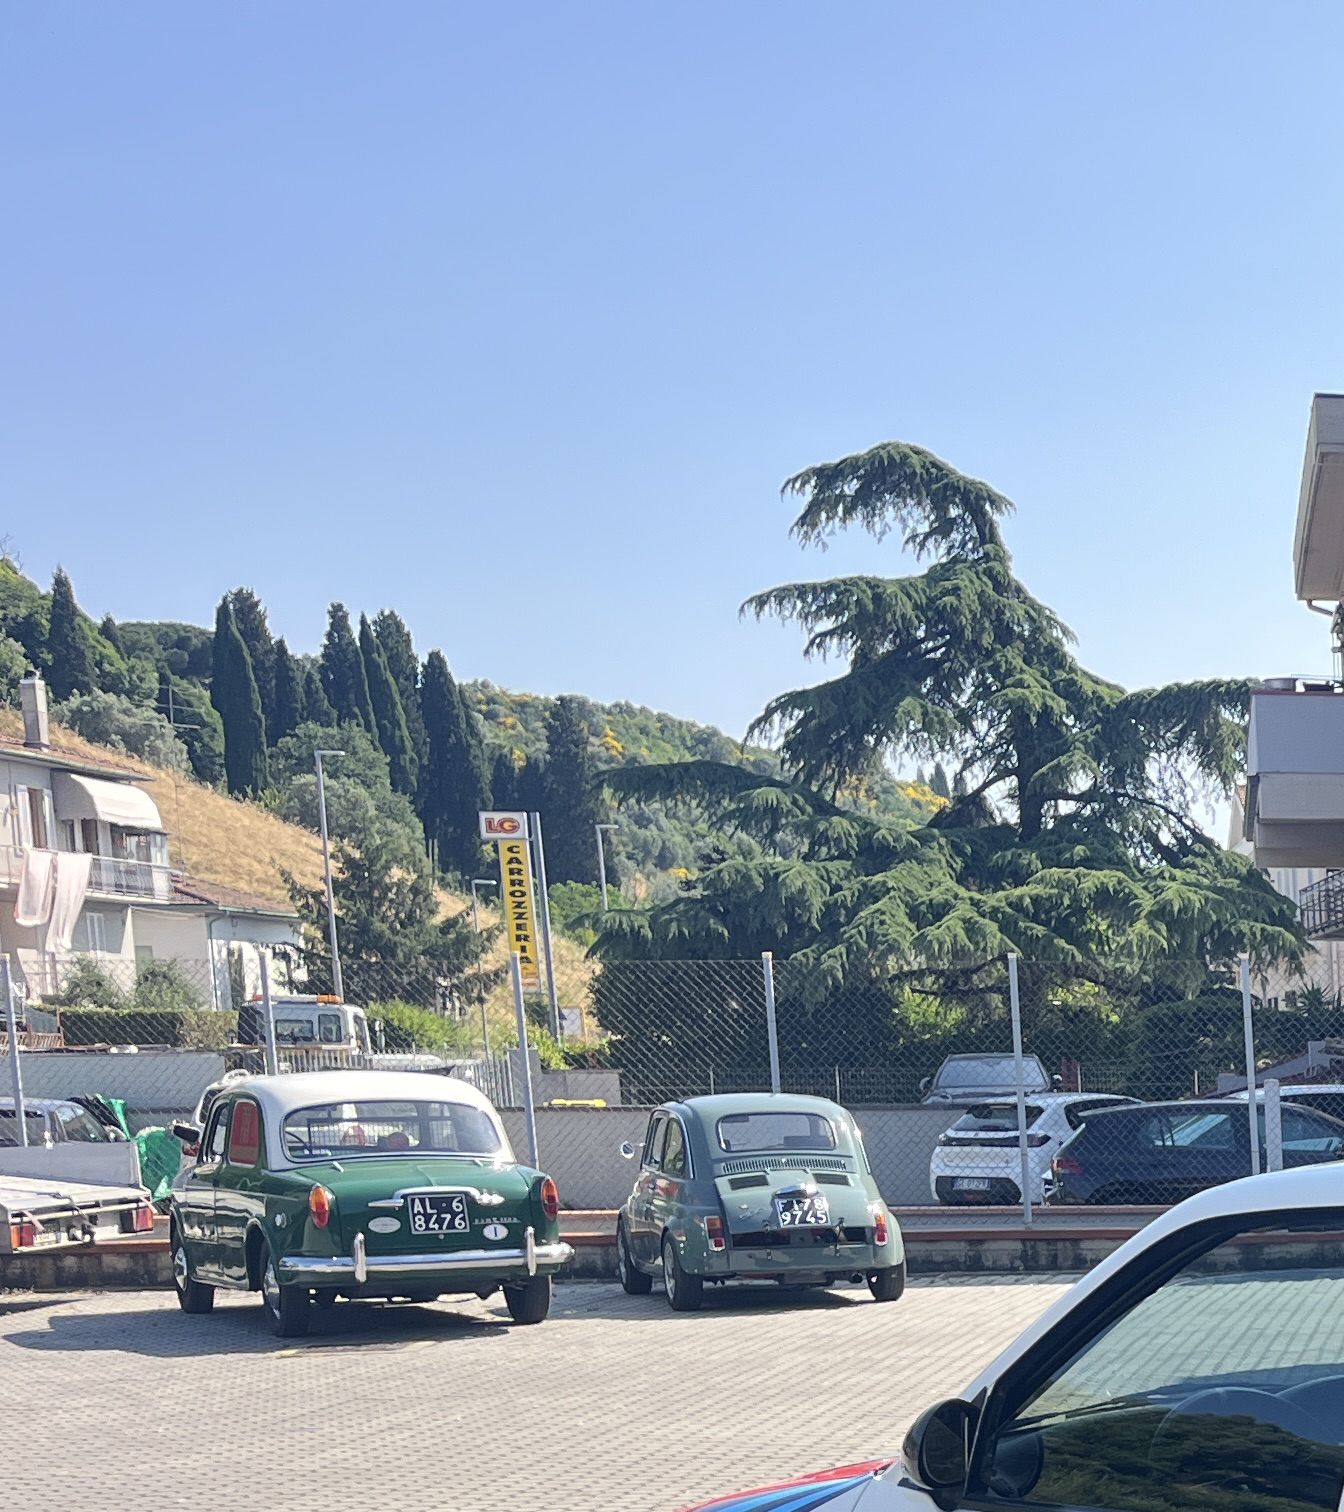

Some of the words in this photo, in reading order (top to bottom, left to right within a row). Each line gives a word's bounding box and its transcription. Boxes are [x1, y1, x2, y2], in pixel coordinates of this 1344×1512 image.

[485, 817, 520, 834] LG
[506, 845, 533, 964] CARROZZERIA
[413, 1197, 437, 1214] AL
[452, 1197, 463, 1212] 6
[414, 1213, 466, 1231] 8476
[781, 1210, 827, 1225] 9745
